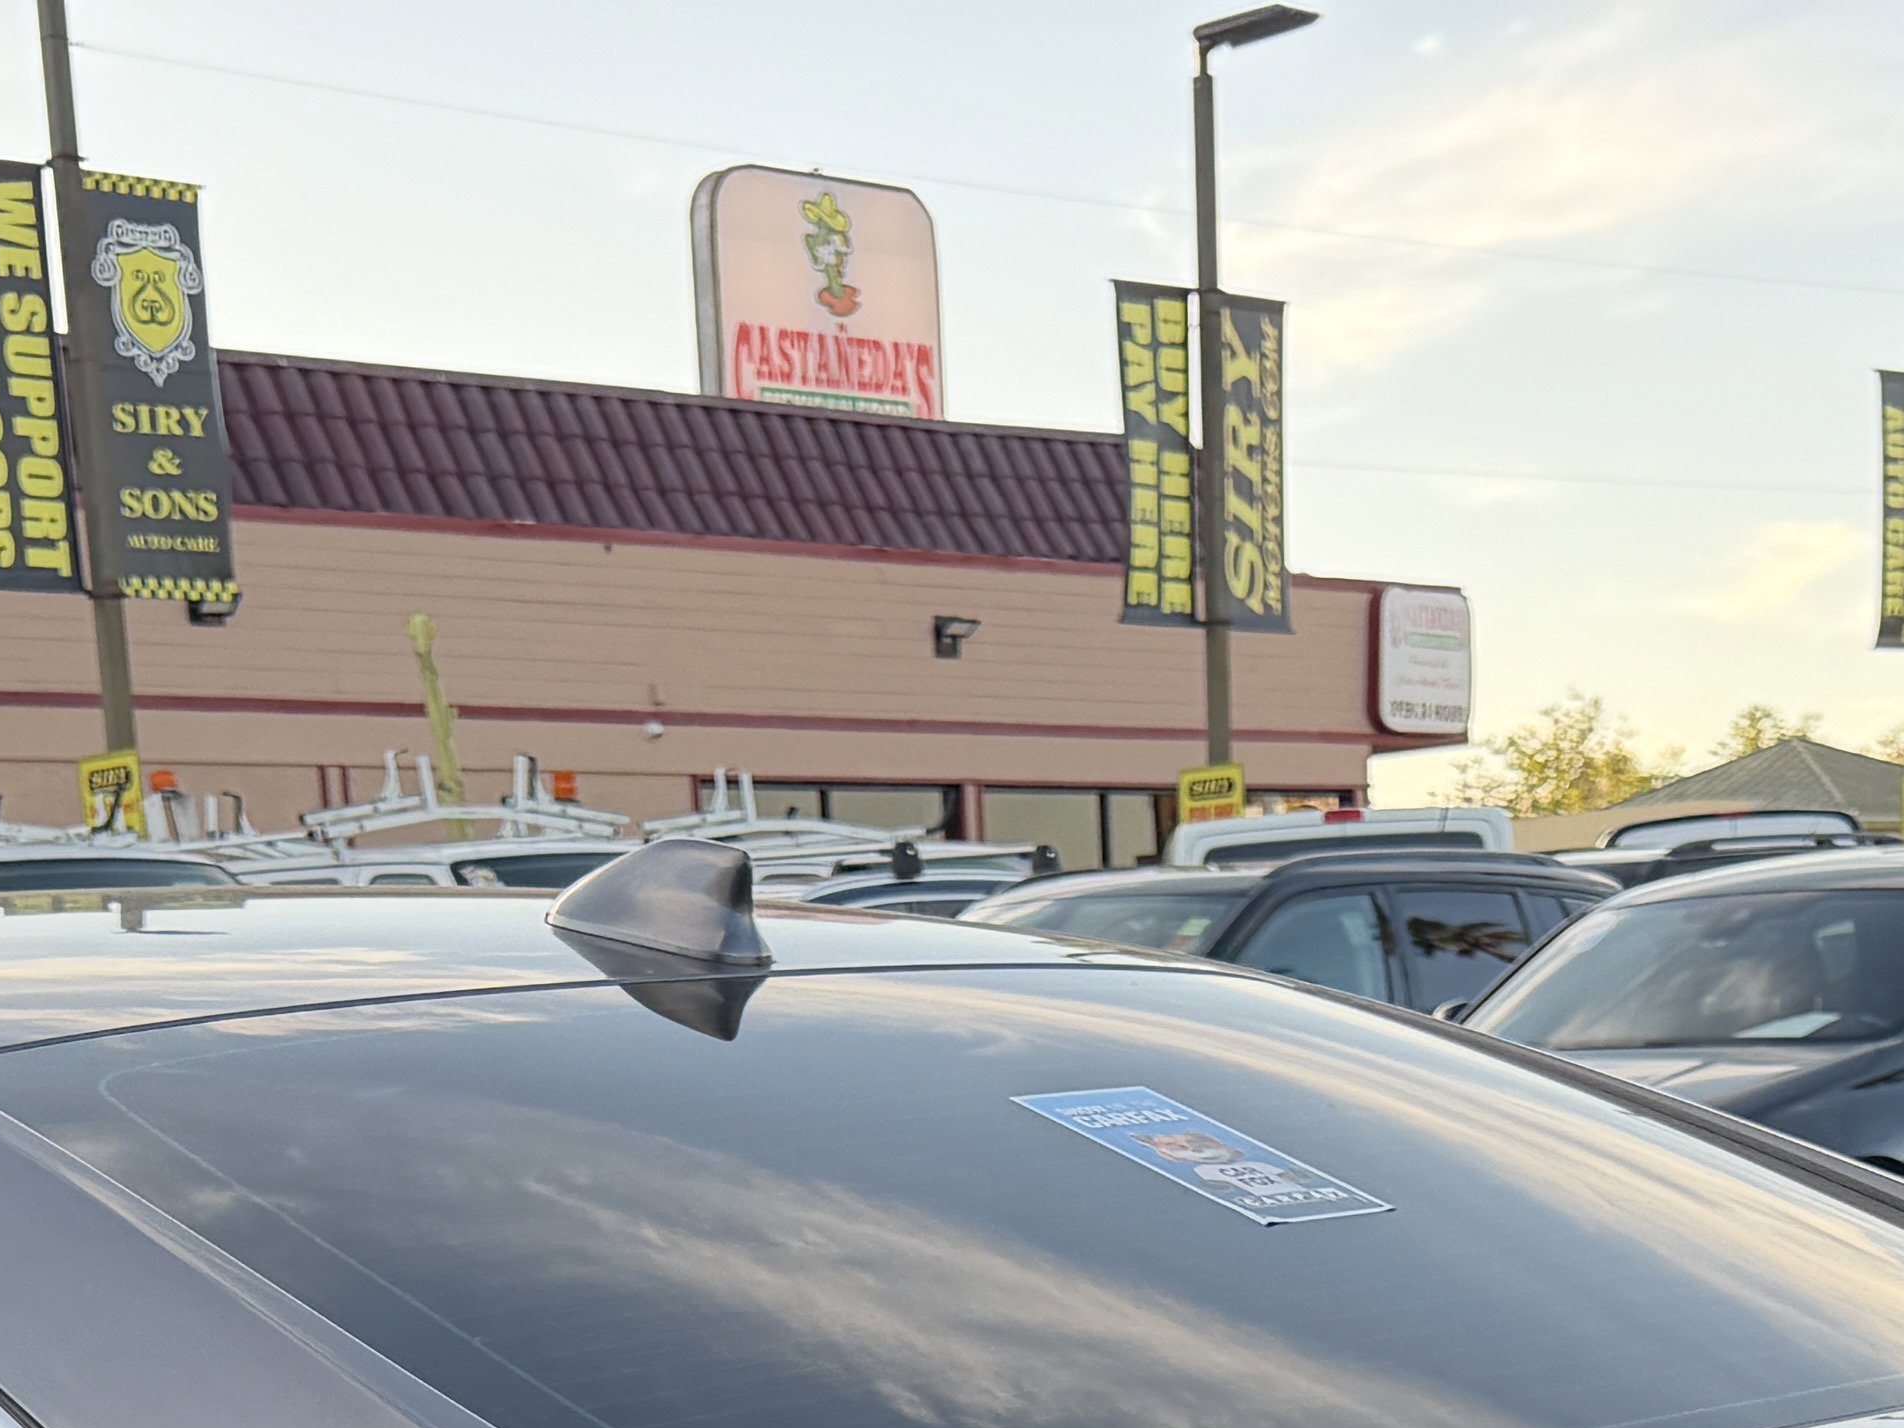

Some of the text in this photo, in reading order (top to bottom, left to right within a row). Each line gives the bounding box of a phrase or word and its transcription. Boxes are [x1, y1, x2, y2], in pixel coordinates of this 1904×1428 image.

[111, 401, 210, 438] SIRY
[147, 448, 183, 476] &
[1119, 302, 1159, 606] PAY HERE
[1153, 298, 1192, 615] BUY HERE
[1220, 307, 1265, 616] SIRY
[120, 486, 220, 523] SONS
[126, 534, 220, 554] AUTO CARE
[1071, 1107, 1189, 1129] CARFAX
[1237, 1175, 1276, 1188] FOX
